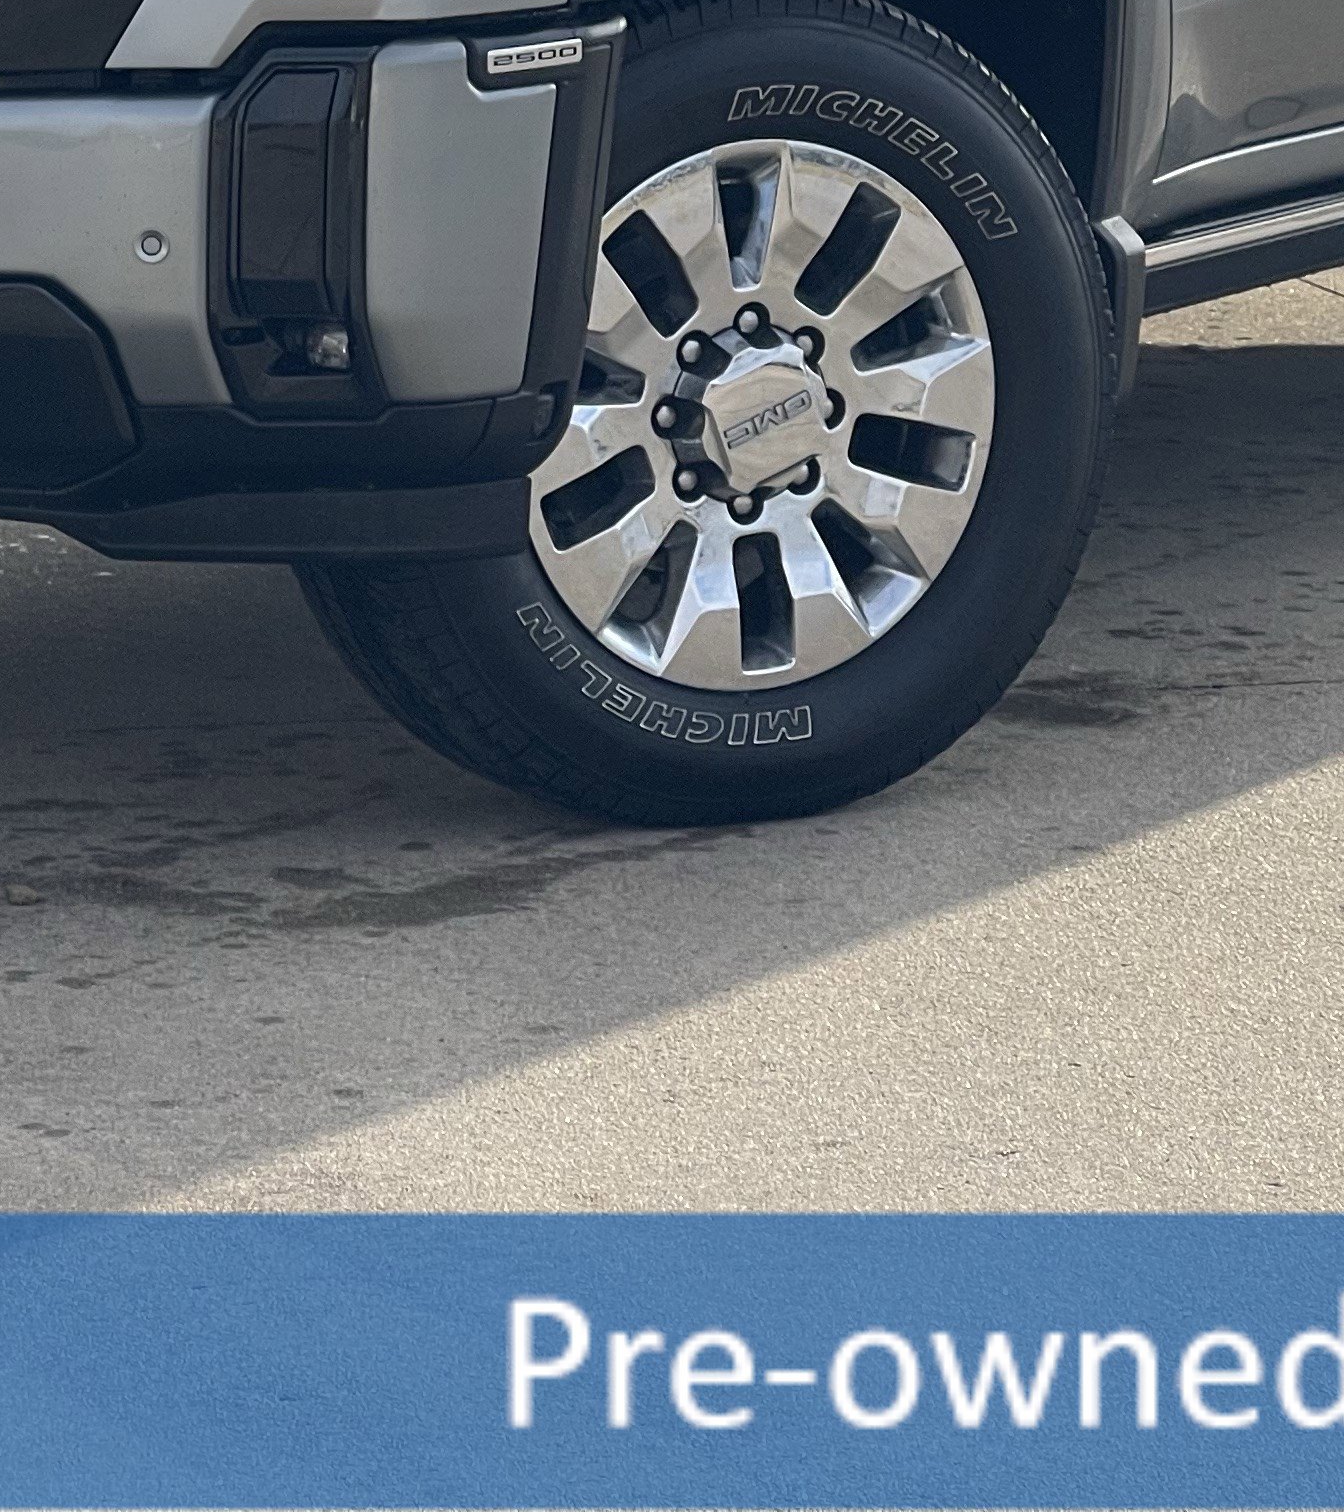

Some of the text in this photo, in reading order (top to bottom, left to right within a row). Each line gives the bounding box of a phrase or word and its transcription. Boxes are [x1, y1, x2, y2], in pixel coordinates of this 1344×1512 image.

[493, 46, 577, 66] 2500
[727, 84, 1018, 240] MICHELIN
[723, 389, 812, 450] GMC
[516, 601, 812, 745] MICHELIN
